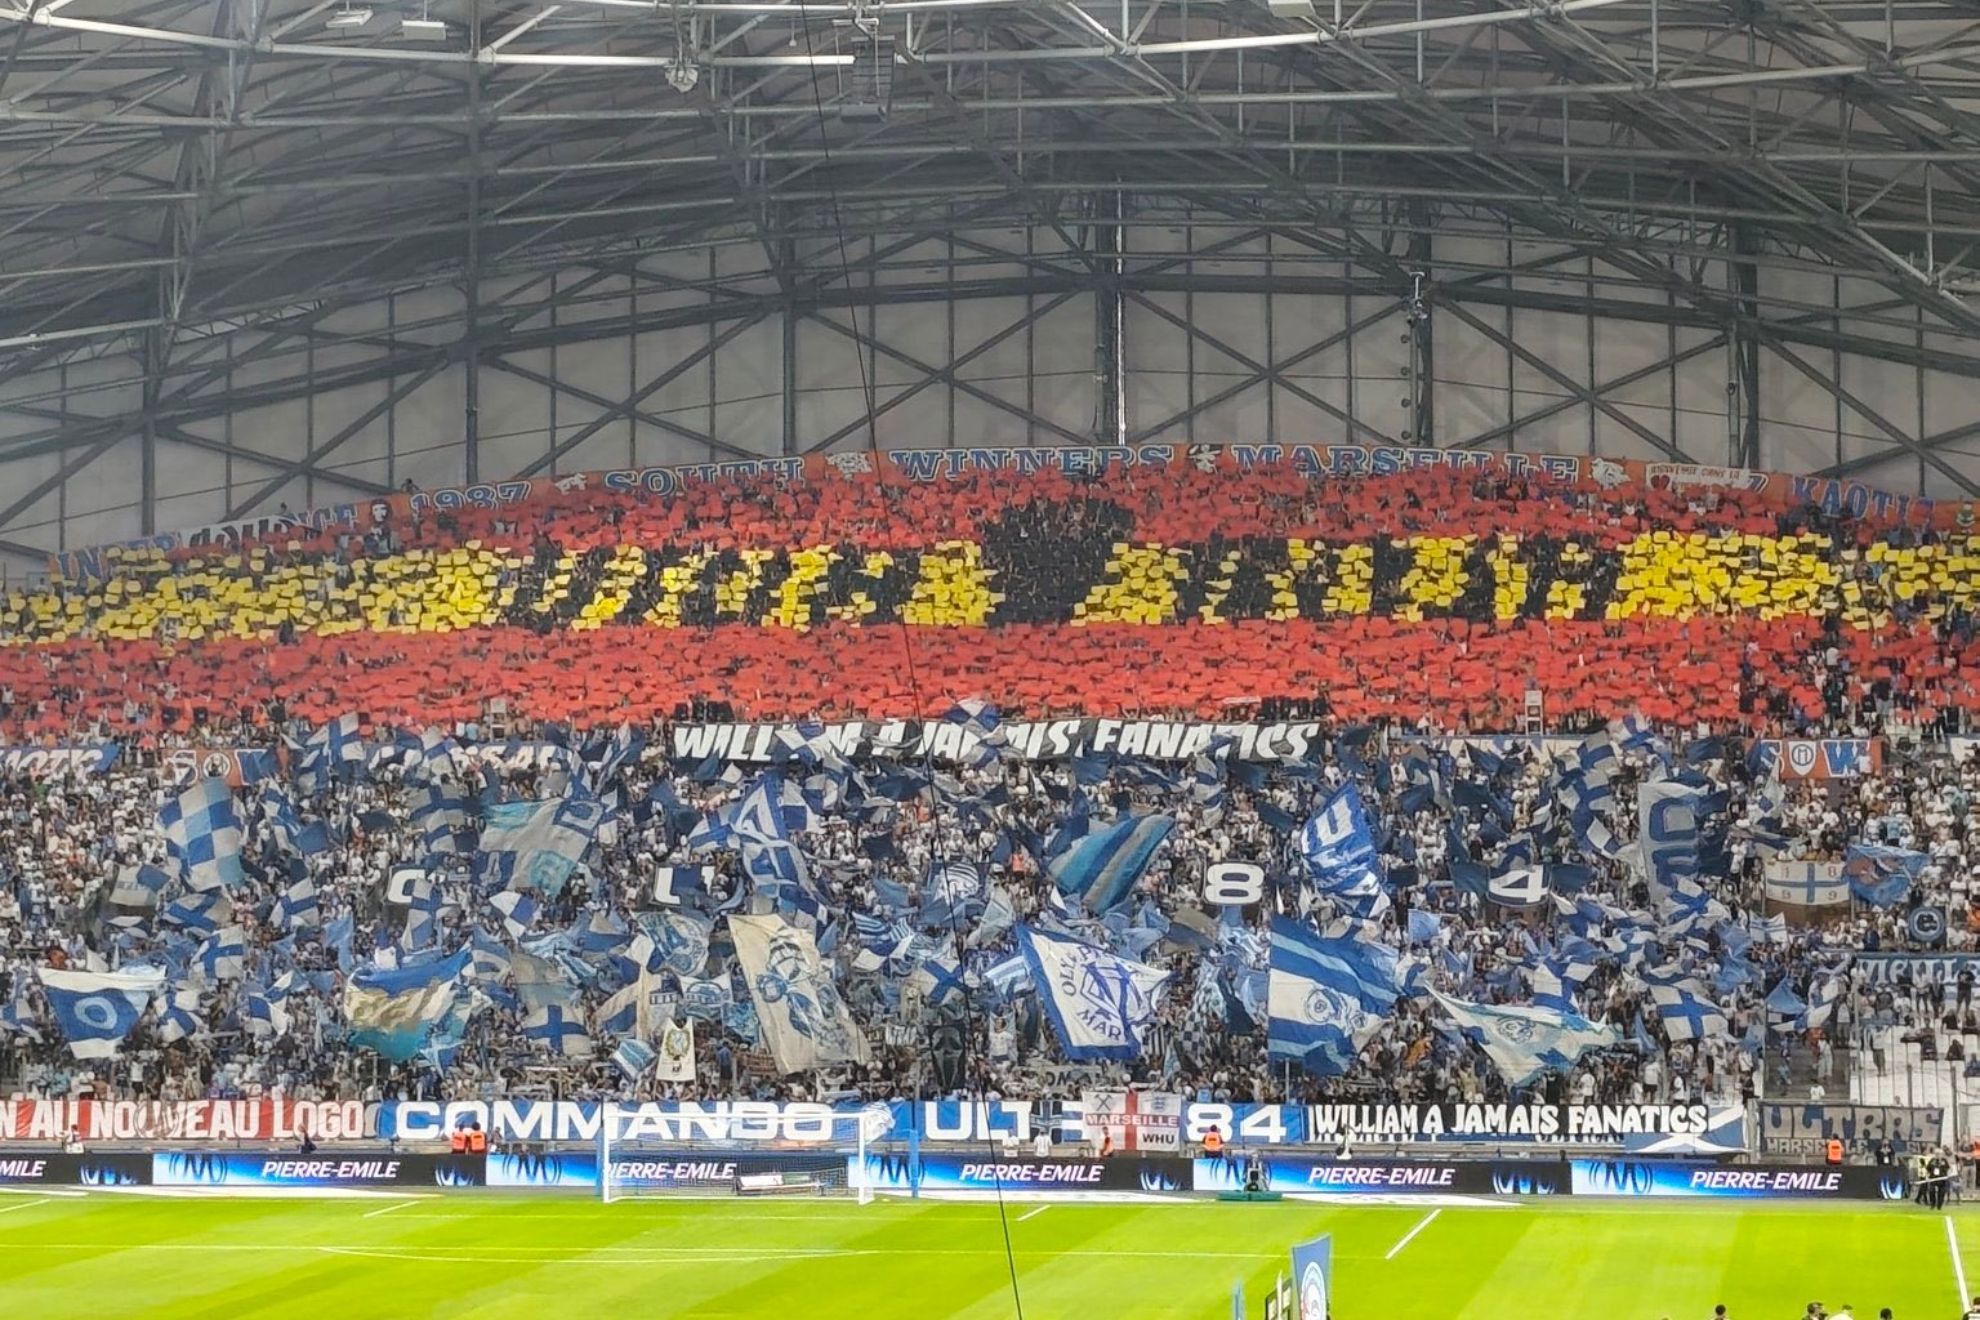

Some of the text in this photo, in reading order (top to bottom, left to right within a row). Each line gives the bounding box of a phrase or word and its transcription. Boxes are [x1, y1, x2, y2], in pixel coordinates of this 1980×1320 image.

[410, 480, 532, 510] 1987
[605, 458, 805, 497] SOUTH
[890, 446, 1174, 482] WINNERS
[1231, 445, 1578, 484] MARSEILLE
[1793, 475, 1934, 526] KAOTI
[674, 723, 863, 761] WILLM
[1205, 863, 1265, 905] 8
[1489, 865, 1550, 904] 4
[30, 1100, 79, 1138] AU
[90, 1100, 261, 1139] NOUVEAU
[271, 1101, 364, 1140] LOGO
[396, 1101, 833, 1141] COMMANDO
[1086, 1113, 1179, 1128] MARSEILLE
[1187, 1104, 1287, 1143] 84
[1315, 1104, 1708, 1134] WILLIAM A JAMAIS FANATICS
[1763, 1105, 1942, 1142] ULTRAS
[1142, 1133, 1175, 1145] WHU
[262, 1160, 400, 1179] PIERRE-EMILE
[959, 1164, 1105, 1183] PIERRE-EMILE
[1308, 1166, 1455, 1186] PIERRE-EMILE
[1690, 1171, 1843, 1191] PIERRE-EMILE
